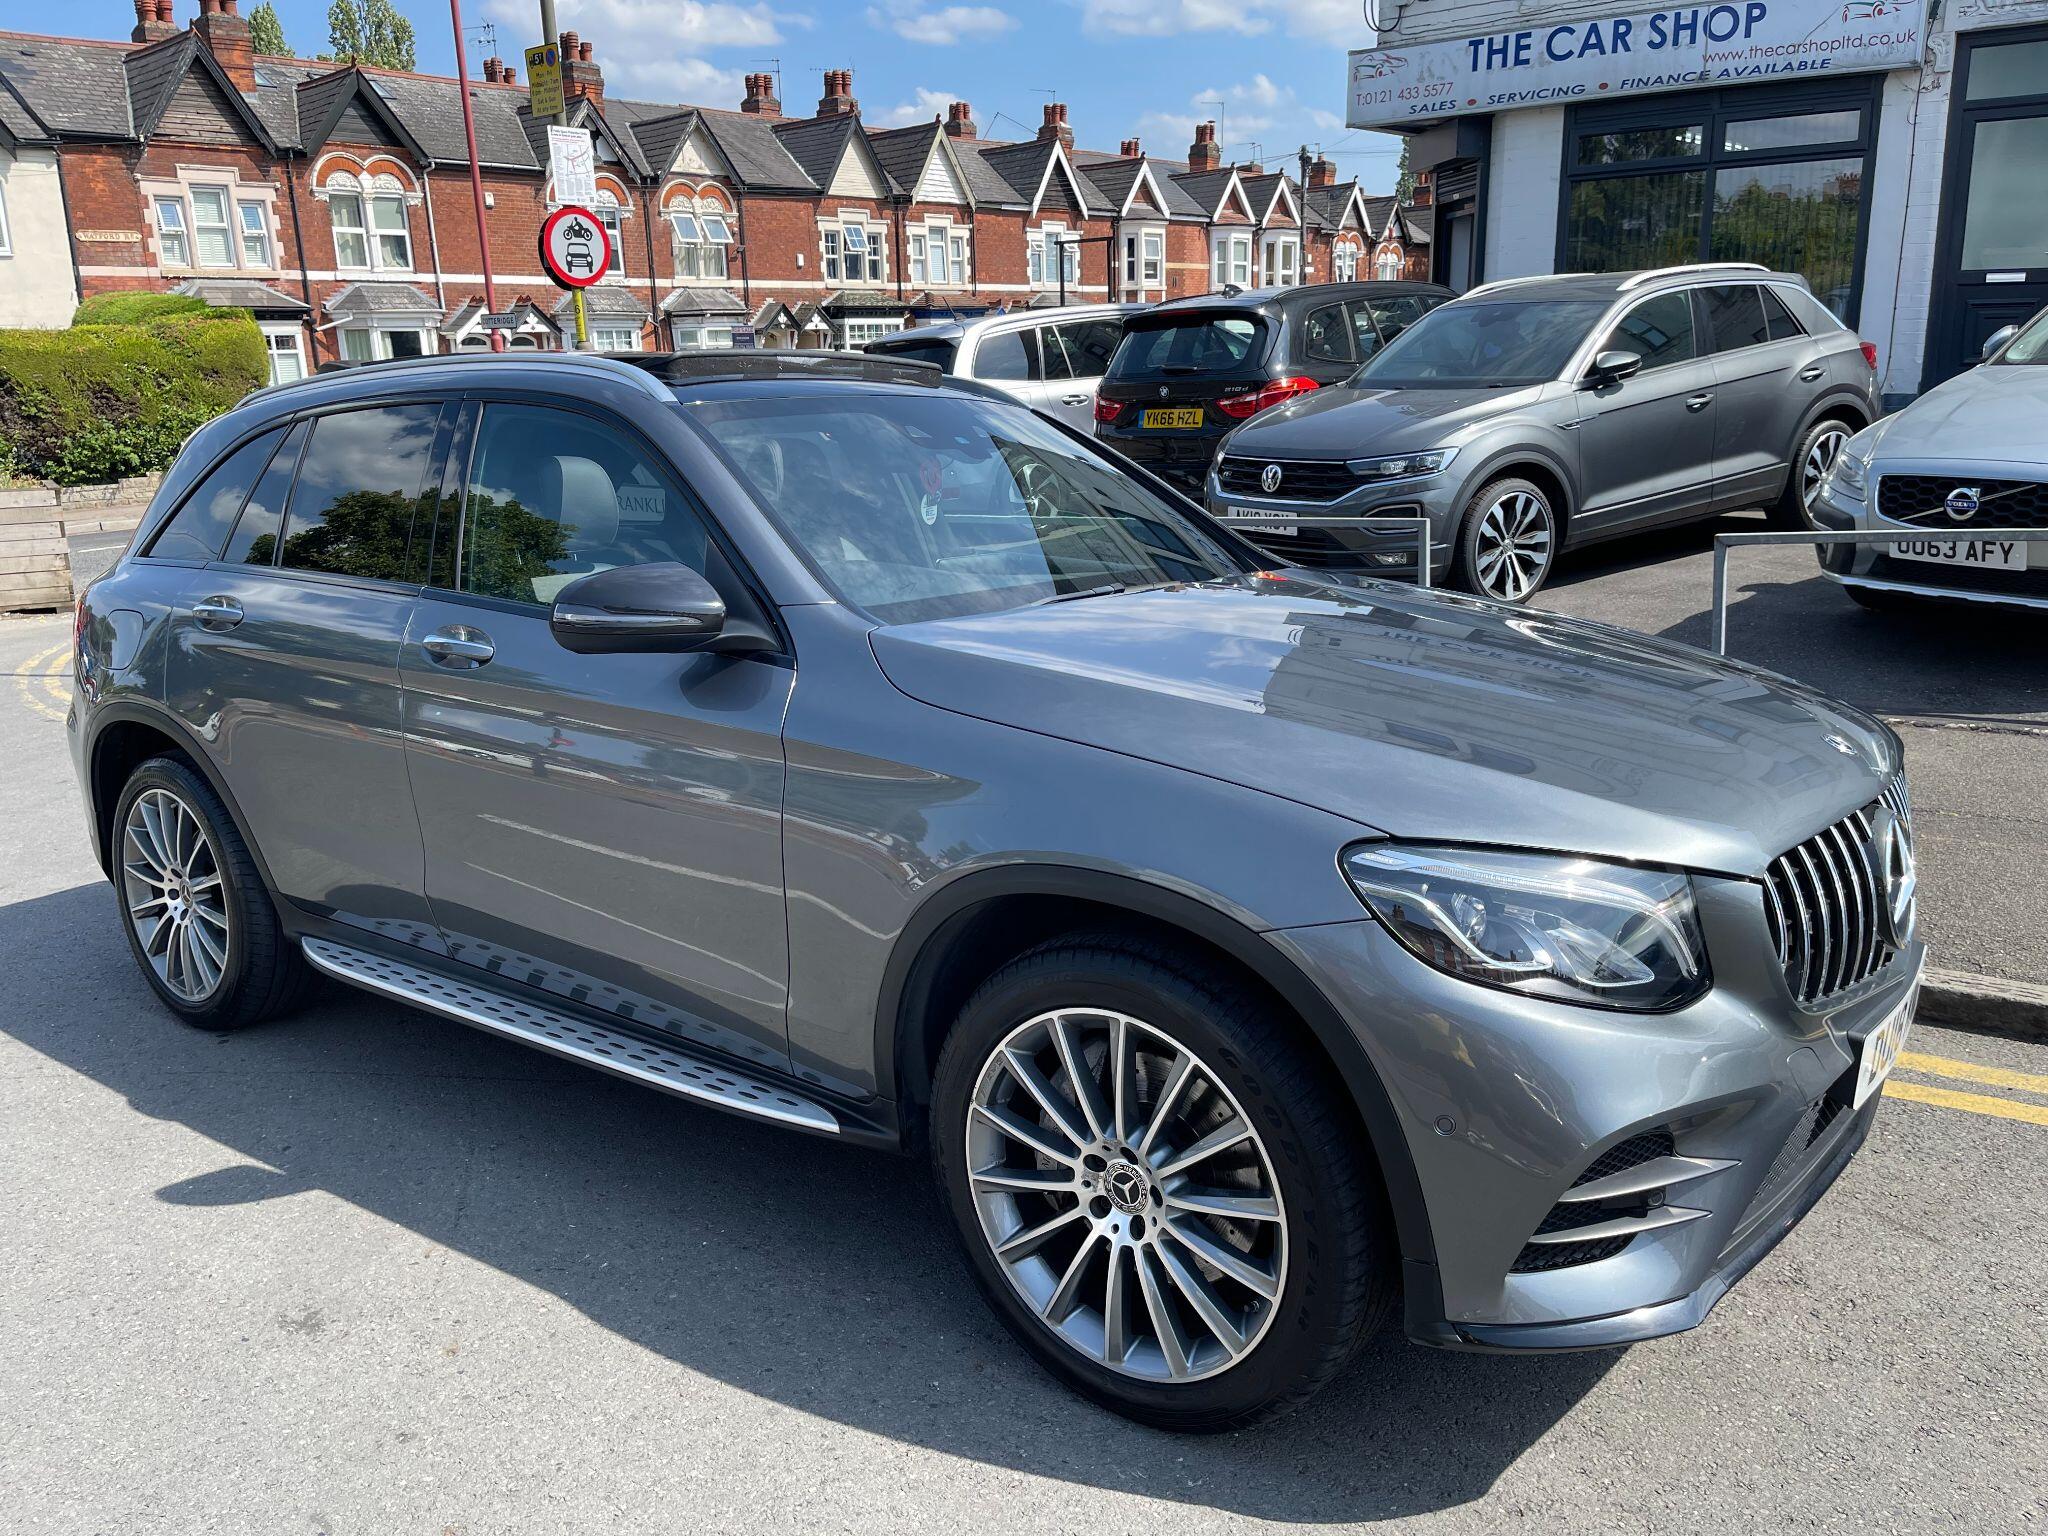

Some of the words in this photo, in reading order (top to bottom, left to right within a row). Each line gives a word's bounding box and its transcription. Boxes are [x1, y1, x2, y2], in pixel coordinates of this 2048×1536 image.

[1468, 31, 1533, 72] THE
[1546, 19, 1632, 62] CAR
[1646, 2, 1767, 50] SHOP
[1701, 28, 1917, 64] www.thecarshopltd.co.uk
[1356, 89, 1393, 106] T:0121
[1397, 86, 1420, 101] 433
[1423, 82, 1454, 98] 5577
[1408, 99, 1457, 115] SALES
[1487, 84, 1586, 105] SERVICING
[1620, 69, 1711, 90] FINANCE
[1717, 58, 1832, 79] AVAILABLE
[83, 232, 120, 240] WATFORD
[1146, 412, 1174, 426] YK66
[1177, 411, 1200, 425] HZL
[1946, 499, 1976, 508] VOLVO
[1964, 541, 2014, 564] AFY
